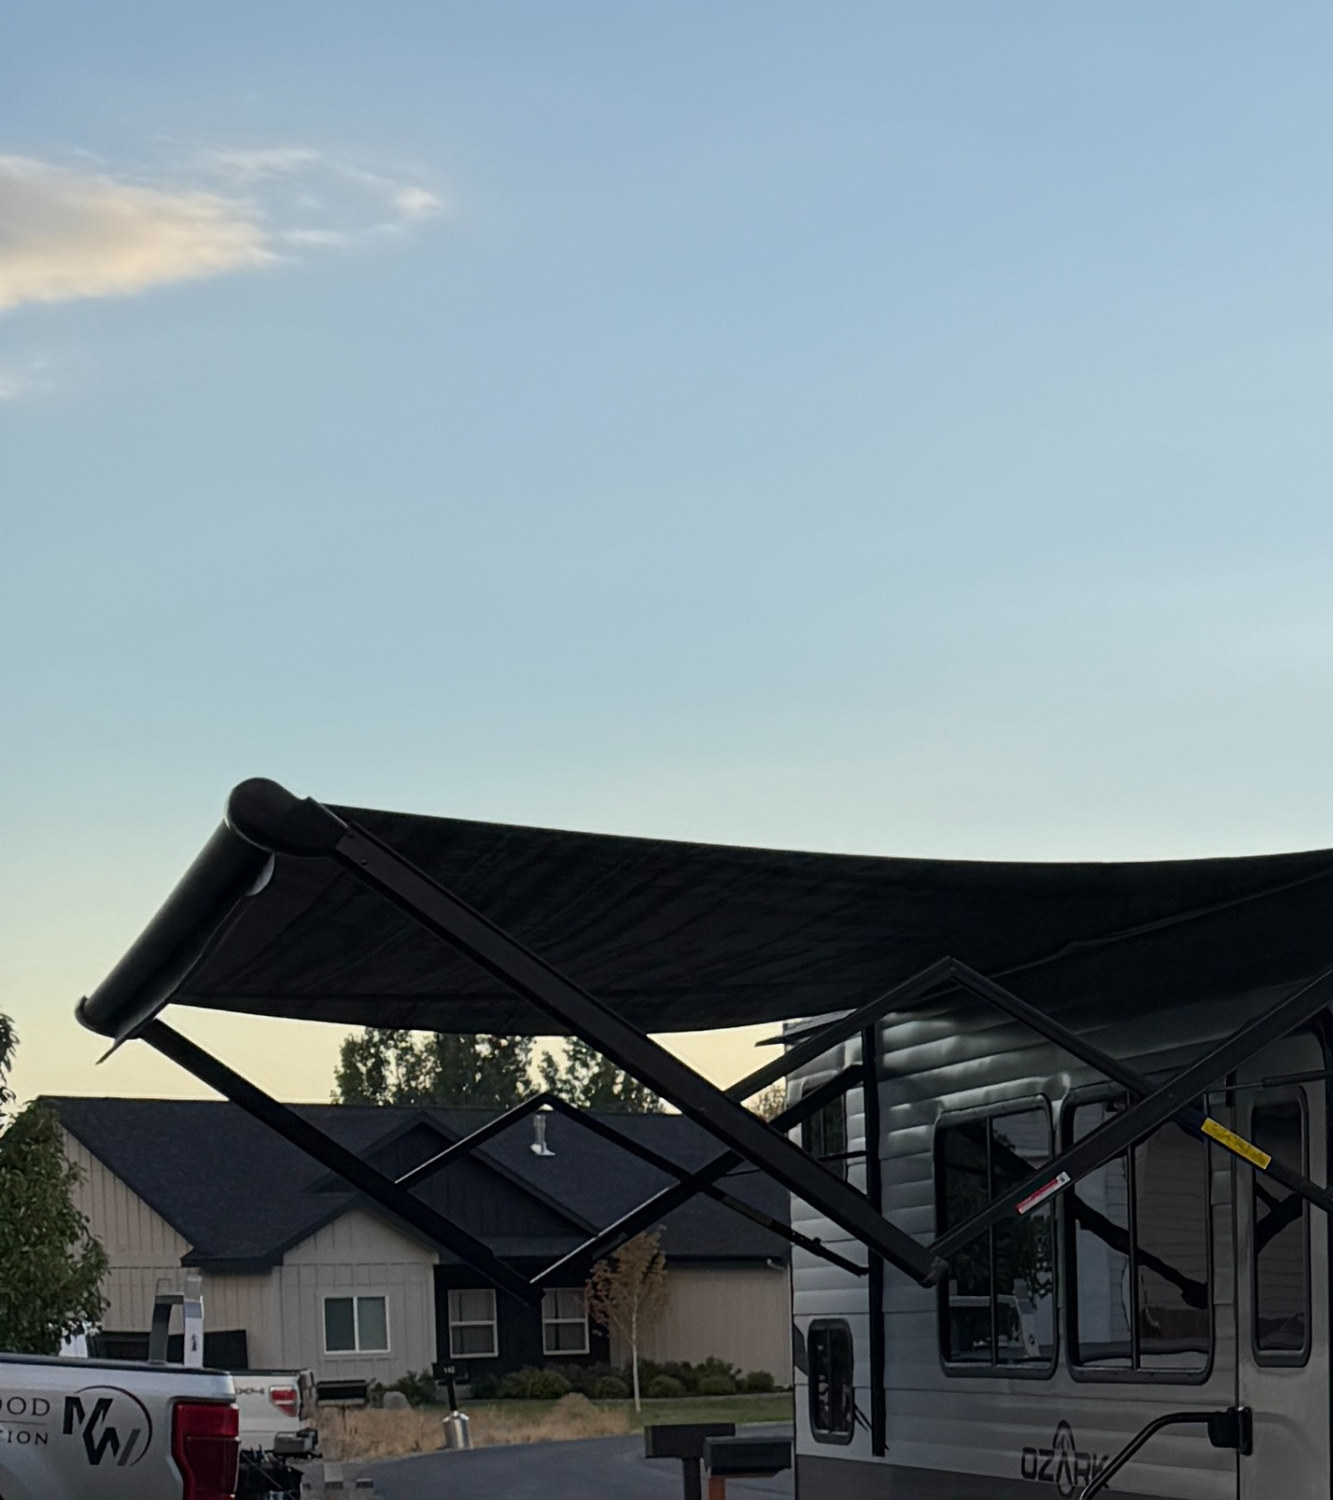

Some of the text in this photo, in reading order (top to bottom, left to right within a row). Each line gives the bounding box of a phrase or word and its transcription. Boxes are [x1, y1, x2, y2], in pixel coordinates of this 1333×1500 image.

[0, 1396, 50, 1417] OD
[0, 1428, 49, 1446] ION
[1021, 1446, 1109, 1489] OZARK
